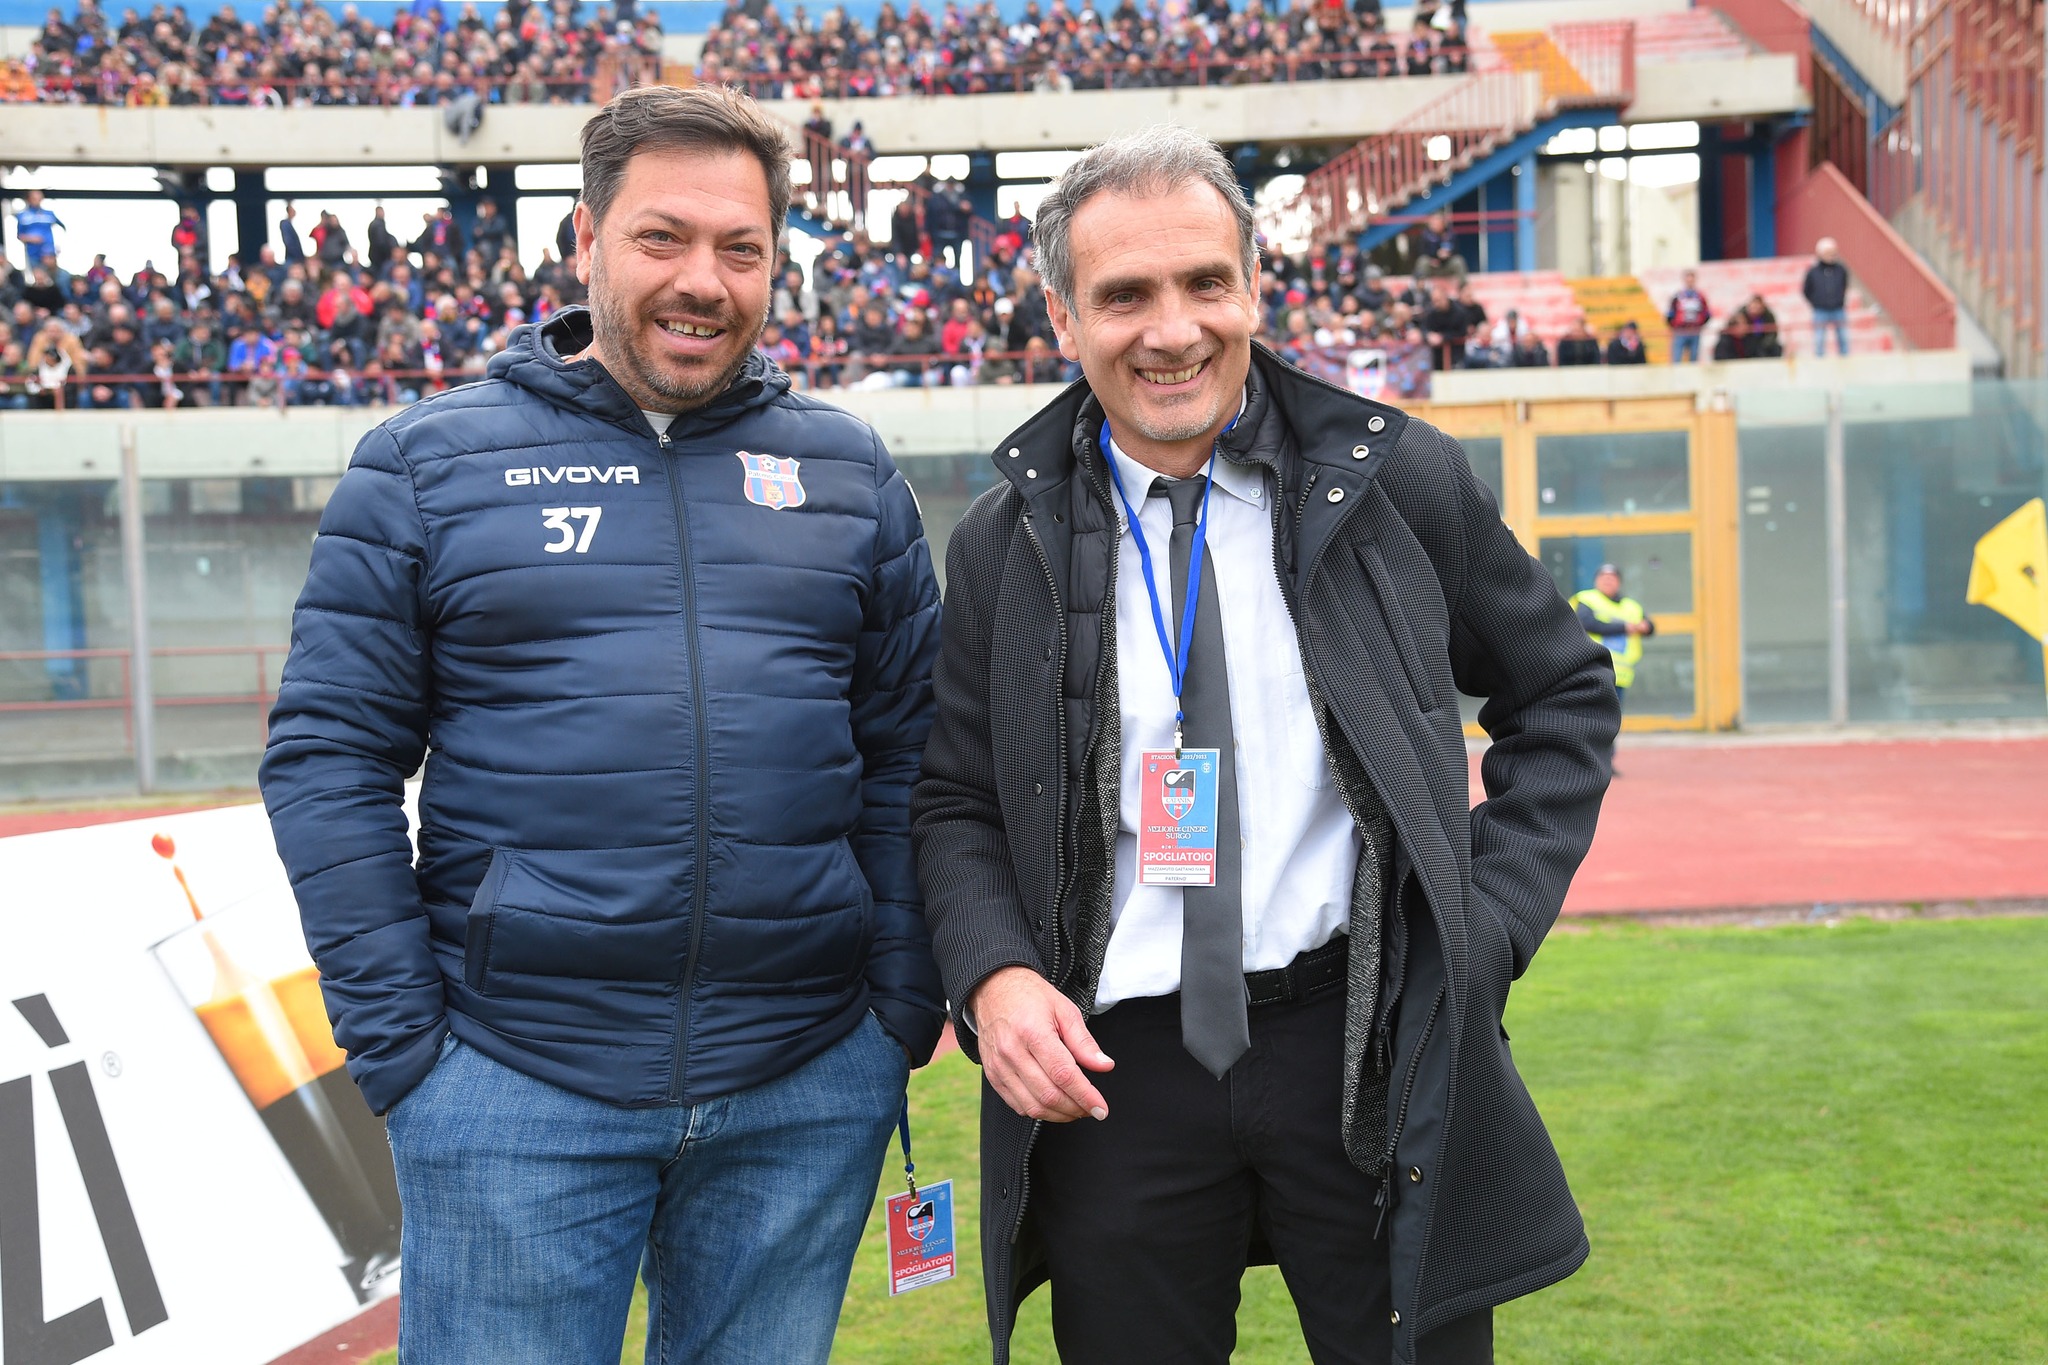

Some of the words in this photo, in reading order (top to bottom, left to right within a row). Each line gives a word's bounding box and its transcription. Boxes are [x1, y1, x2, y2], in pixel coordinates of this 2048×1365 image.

[504, 465, 640, 486] GIVOVA
[541, 506, 602, 553] 37
[1165, 832, 1192, 840] SURGO
[1143, 851, 1213, 862] SPOGLIATOIO
[895, 1255, 952, 1278] SPOGLIATOIO
